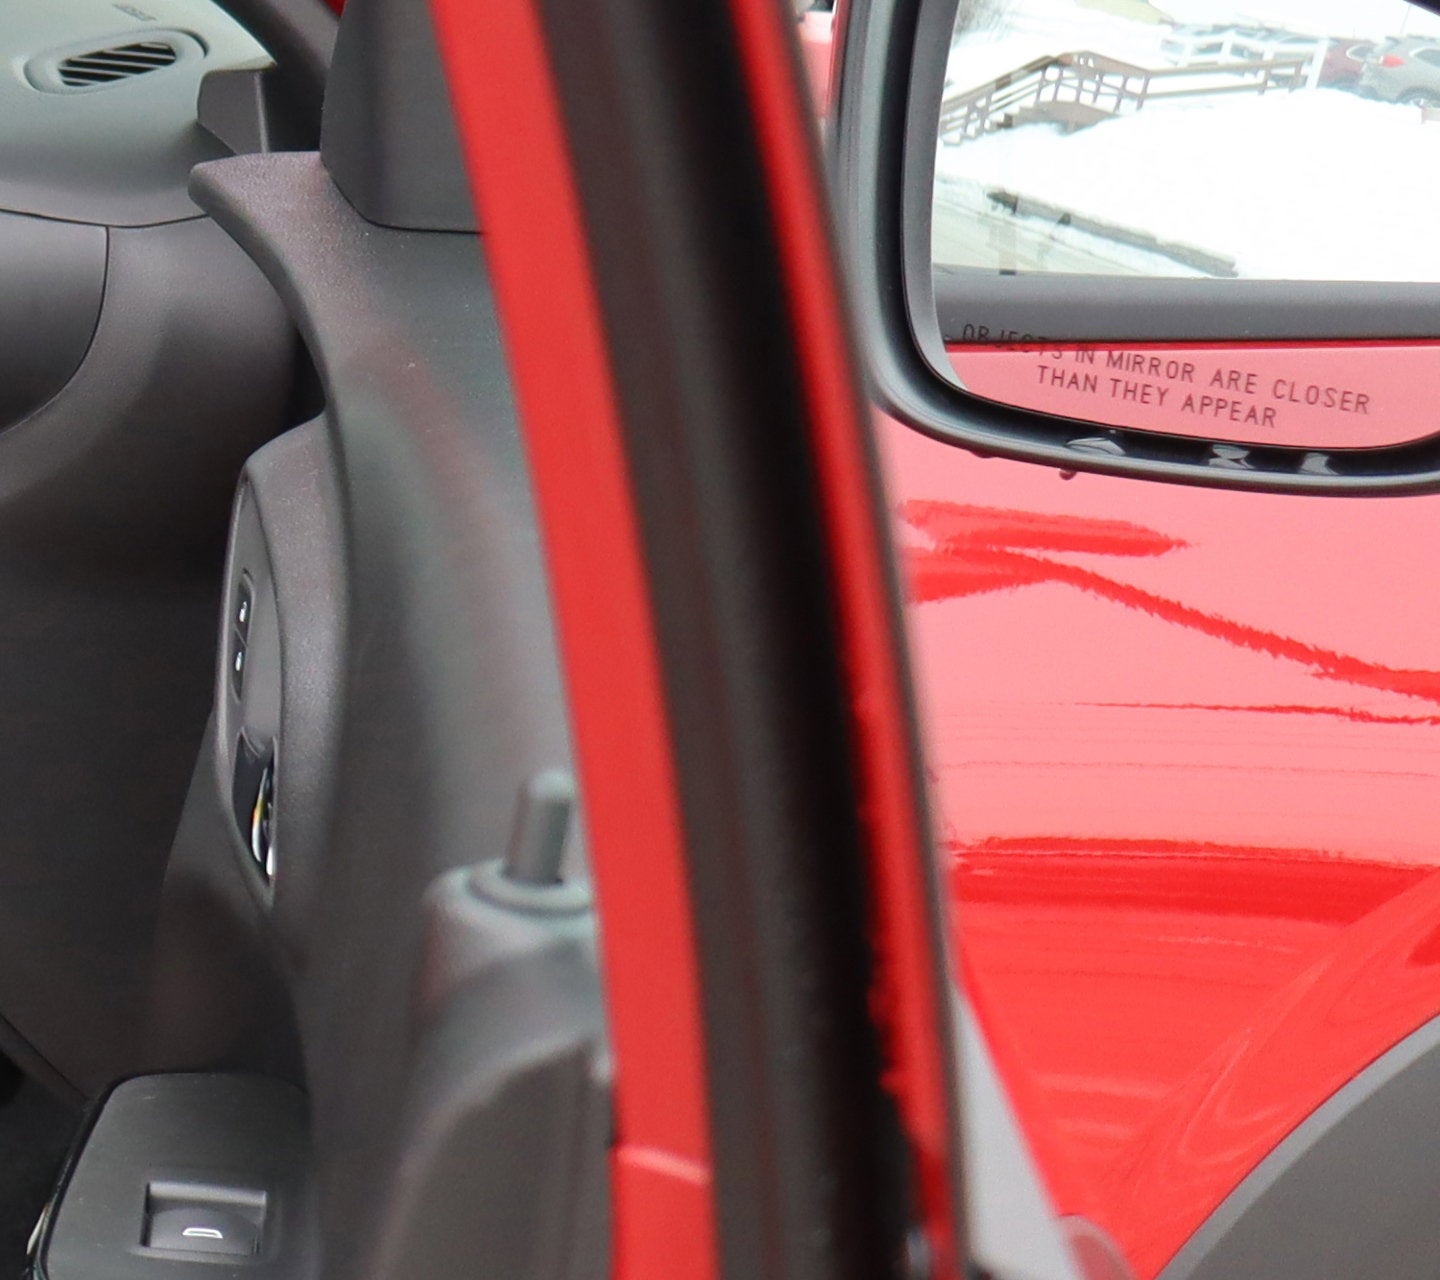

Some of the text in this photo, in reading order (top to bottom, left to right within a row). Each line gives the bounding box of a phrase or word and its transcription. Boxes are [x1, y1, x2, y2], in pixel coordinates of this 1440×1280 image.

[962, 323, 1370, 415] OBJECTS IN MIRROR ARE CLOSER
[1038, 365, 1277, 429] THAN THEY APPEAR
